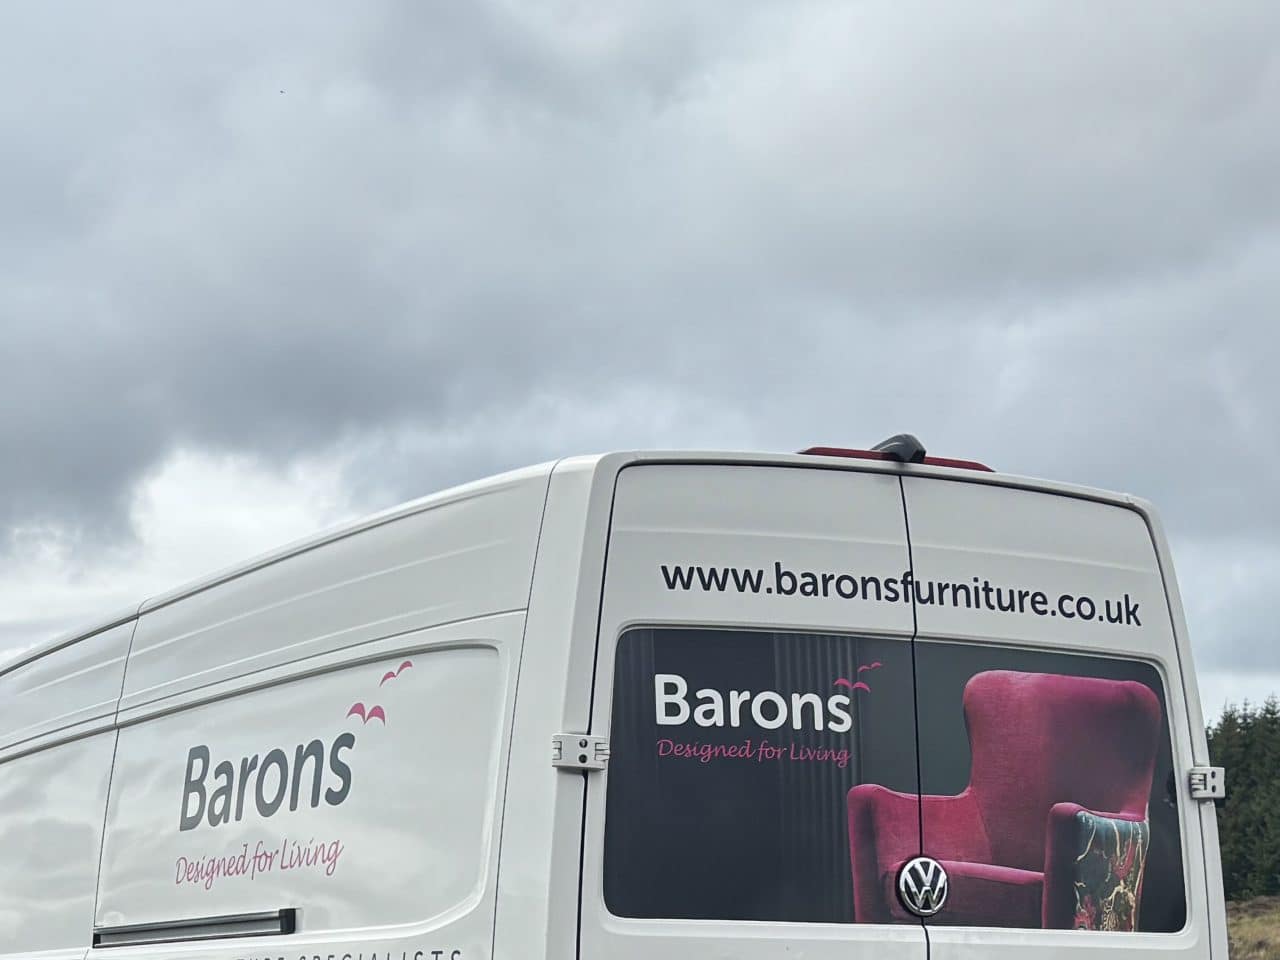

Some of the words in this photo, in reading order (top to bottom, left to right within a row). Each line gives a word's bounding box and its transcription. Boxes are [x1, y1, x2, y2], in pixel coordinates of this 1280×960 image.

[660, 561, 1143, 627] www.baronsfurniture.co.uk
[654, 673, 853, 733] Barons
[179, 732, 356, 832] Barons
[656, 738, 755, 763] Designed
[753, 740, 787, 762] for
[789, 742, 853, 768] Living
[175, 842, 250, 890] Designed
[251, 840, 279, 880] for
[280, 837, 345, 876] Living
